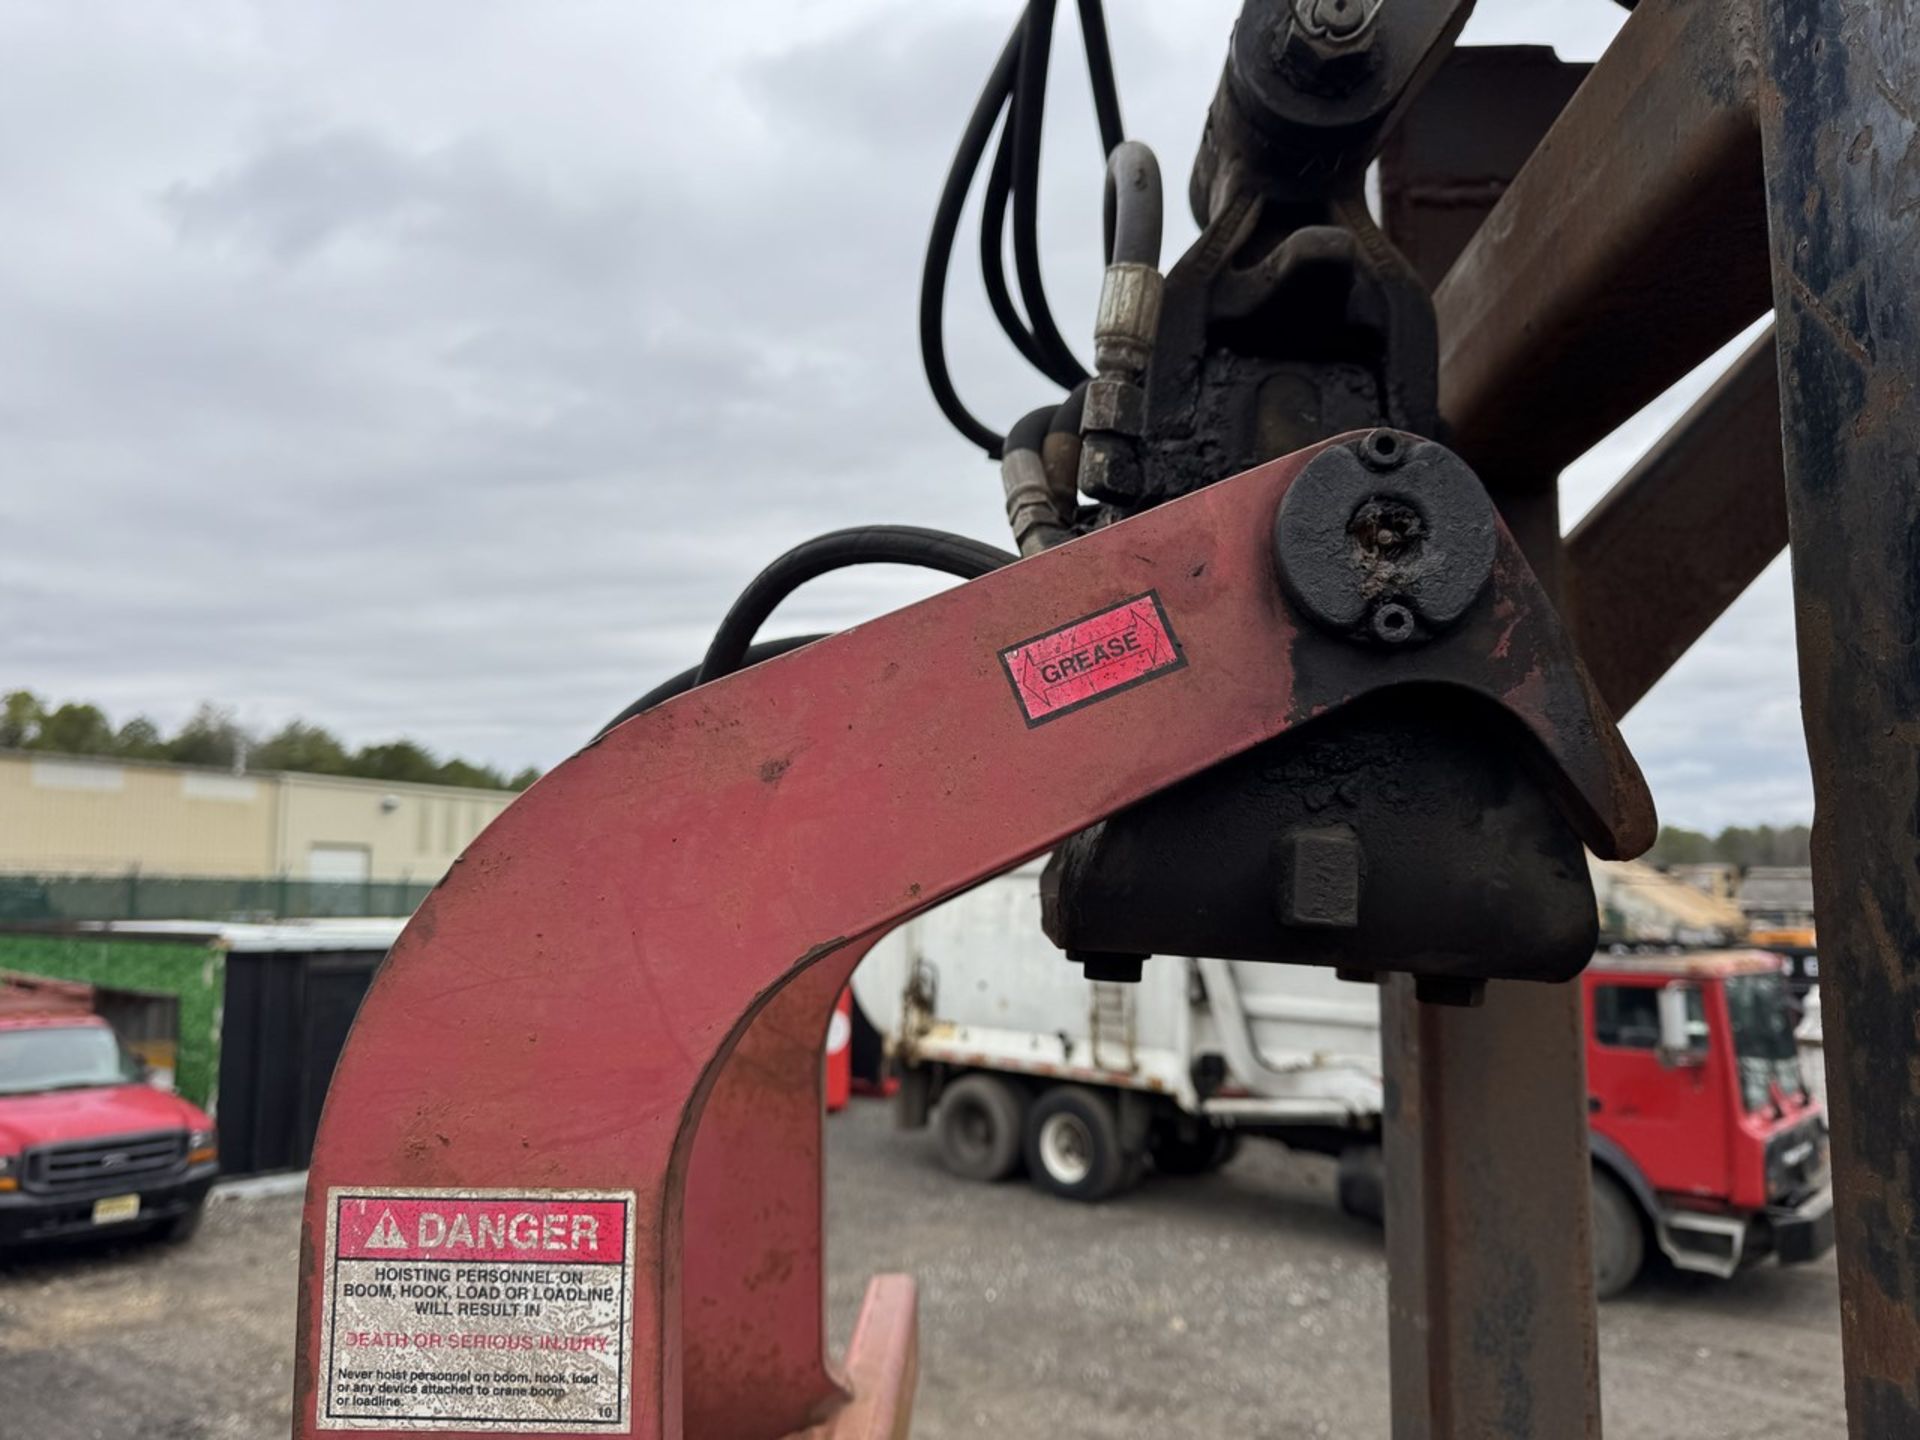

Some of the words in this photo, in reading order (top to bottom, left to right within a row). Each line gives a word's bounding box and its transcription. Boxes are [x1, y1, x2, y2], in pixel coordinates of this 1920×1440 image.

[1041, 631, 1141, 683] GREASE
[417, 1213, 599, 1251] DANGER
[375, 1267, 451, 1282] HOISTING
[456, 1269, 555, 1284] PERSONNEL
[559, 1271, 583, 1285] ON
[343, 1283, 396, 1300] BOOM,
[400, 1285, 452, 1301] HOOK,
[456, 1286, 500, 1300] LOAD
[504, 1286, 529, 1300] OR
[533, 1286, 613, 1301] LOADLINE
[415, 1302, 453, 1315] WILL
[458, 1302, 520, 1316] RESULT
[525, 1304, 540, 1316] IN
[345, 1332, 408, 1348] DEATH
[414, 1333, 441, 1348] OR
[448, 1334, 533, 1350] SERIOUS
[540, 1335, 609, 1351] INJURY
[338, 1369, 373, 1380] Never
[376, 1369, 407, 1380] hoist
[410, 1370, 471, 1382] personnel
[474, 1373, 490, 1382] on
[534, 1373, 570, 1384] hook,
[572, 1373, 598, 1384] load
[337, 1384, 350, 1393] or
[353, 1384, 375, 1395] any
[378, 1383, 418, 1394] device
[421, 1384, 473, 1395] attached
[477, 1385, 490, 1396] to
[493, 1386, 527, 1396] crane
[530, 1385, 566, 1397] boom
[336, 1397, 350, 1406] or
[352, 1395, 404, 1407] loadline.
[599, 1406, 613, 1418] 10
